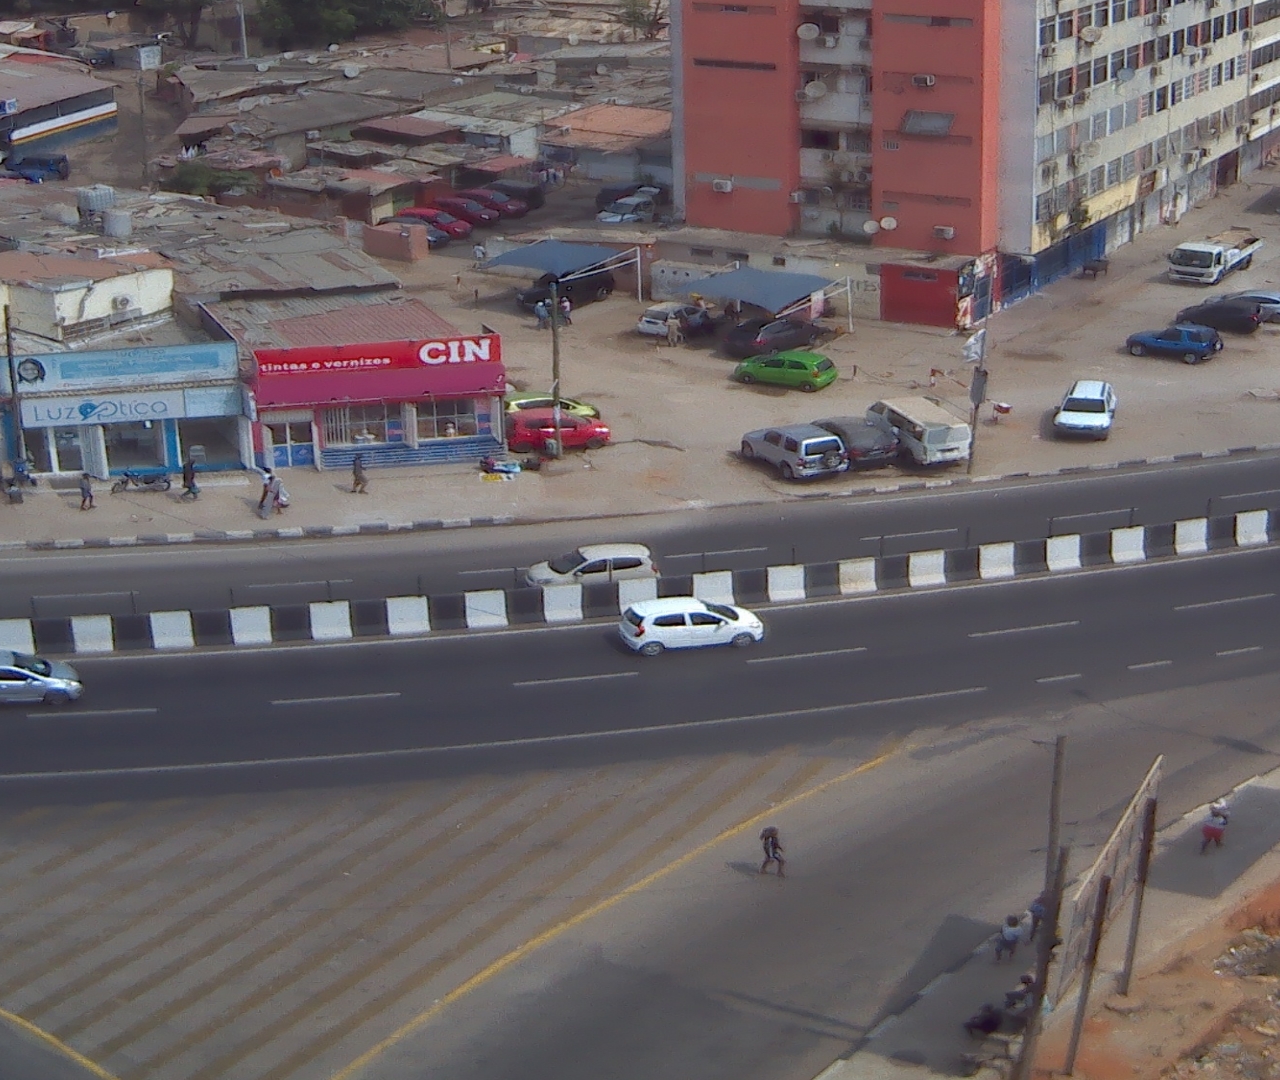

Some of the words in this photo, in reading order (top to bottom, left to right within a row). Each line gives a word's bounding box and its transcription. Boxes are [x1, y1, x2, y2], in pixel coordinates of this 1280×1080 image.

[419, 339, 491, 364] CIN
[261, 362, 307, 372] tintas
[324, 357, 391, 369] vernizes
